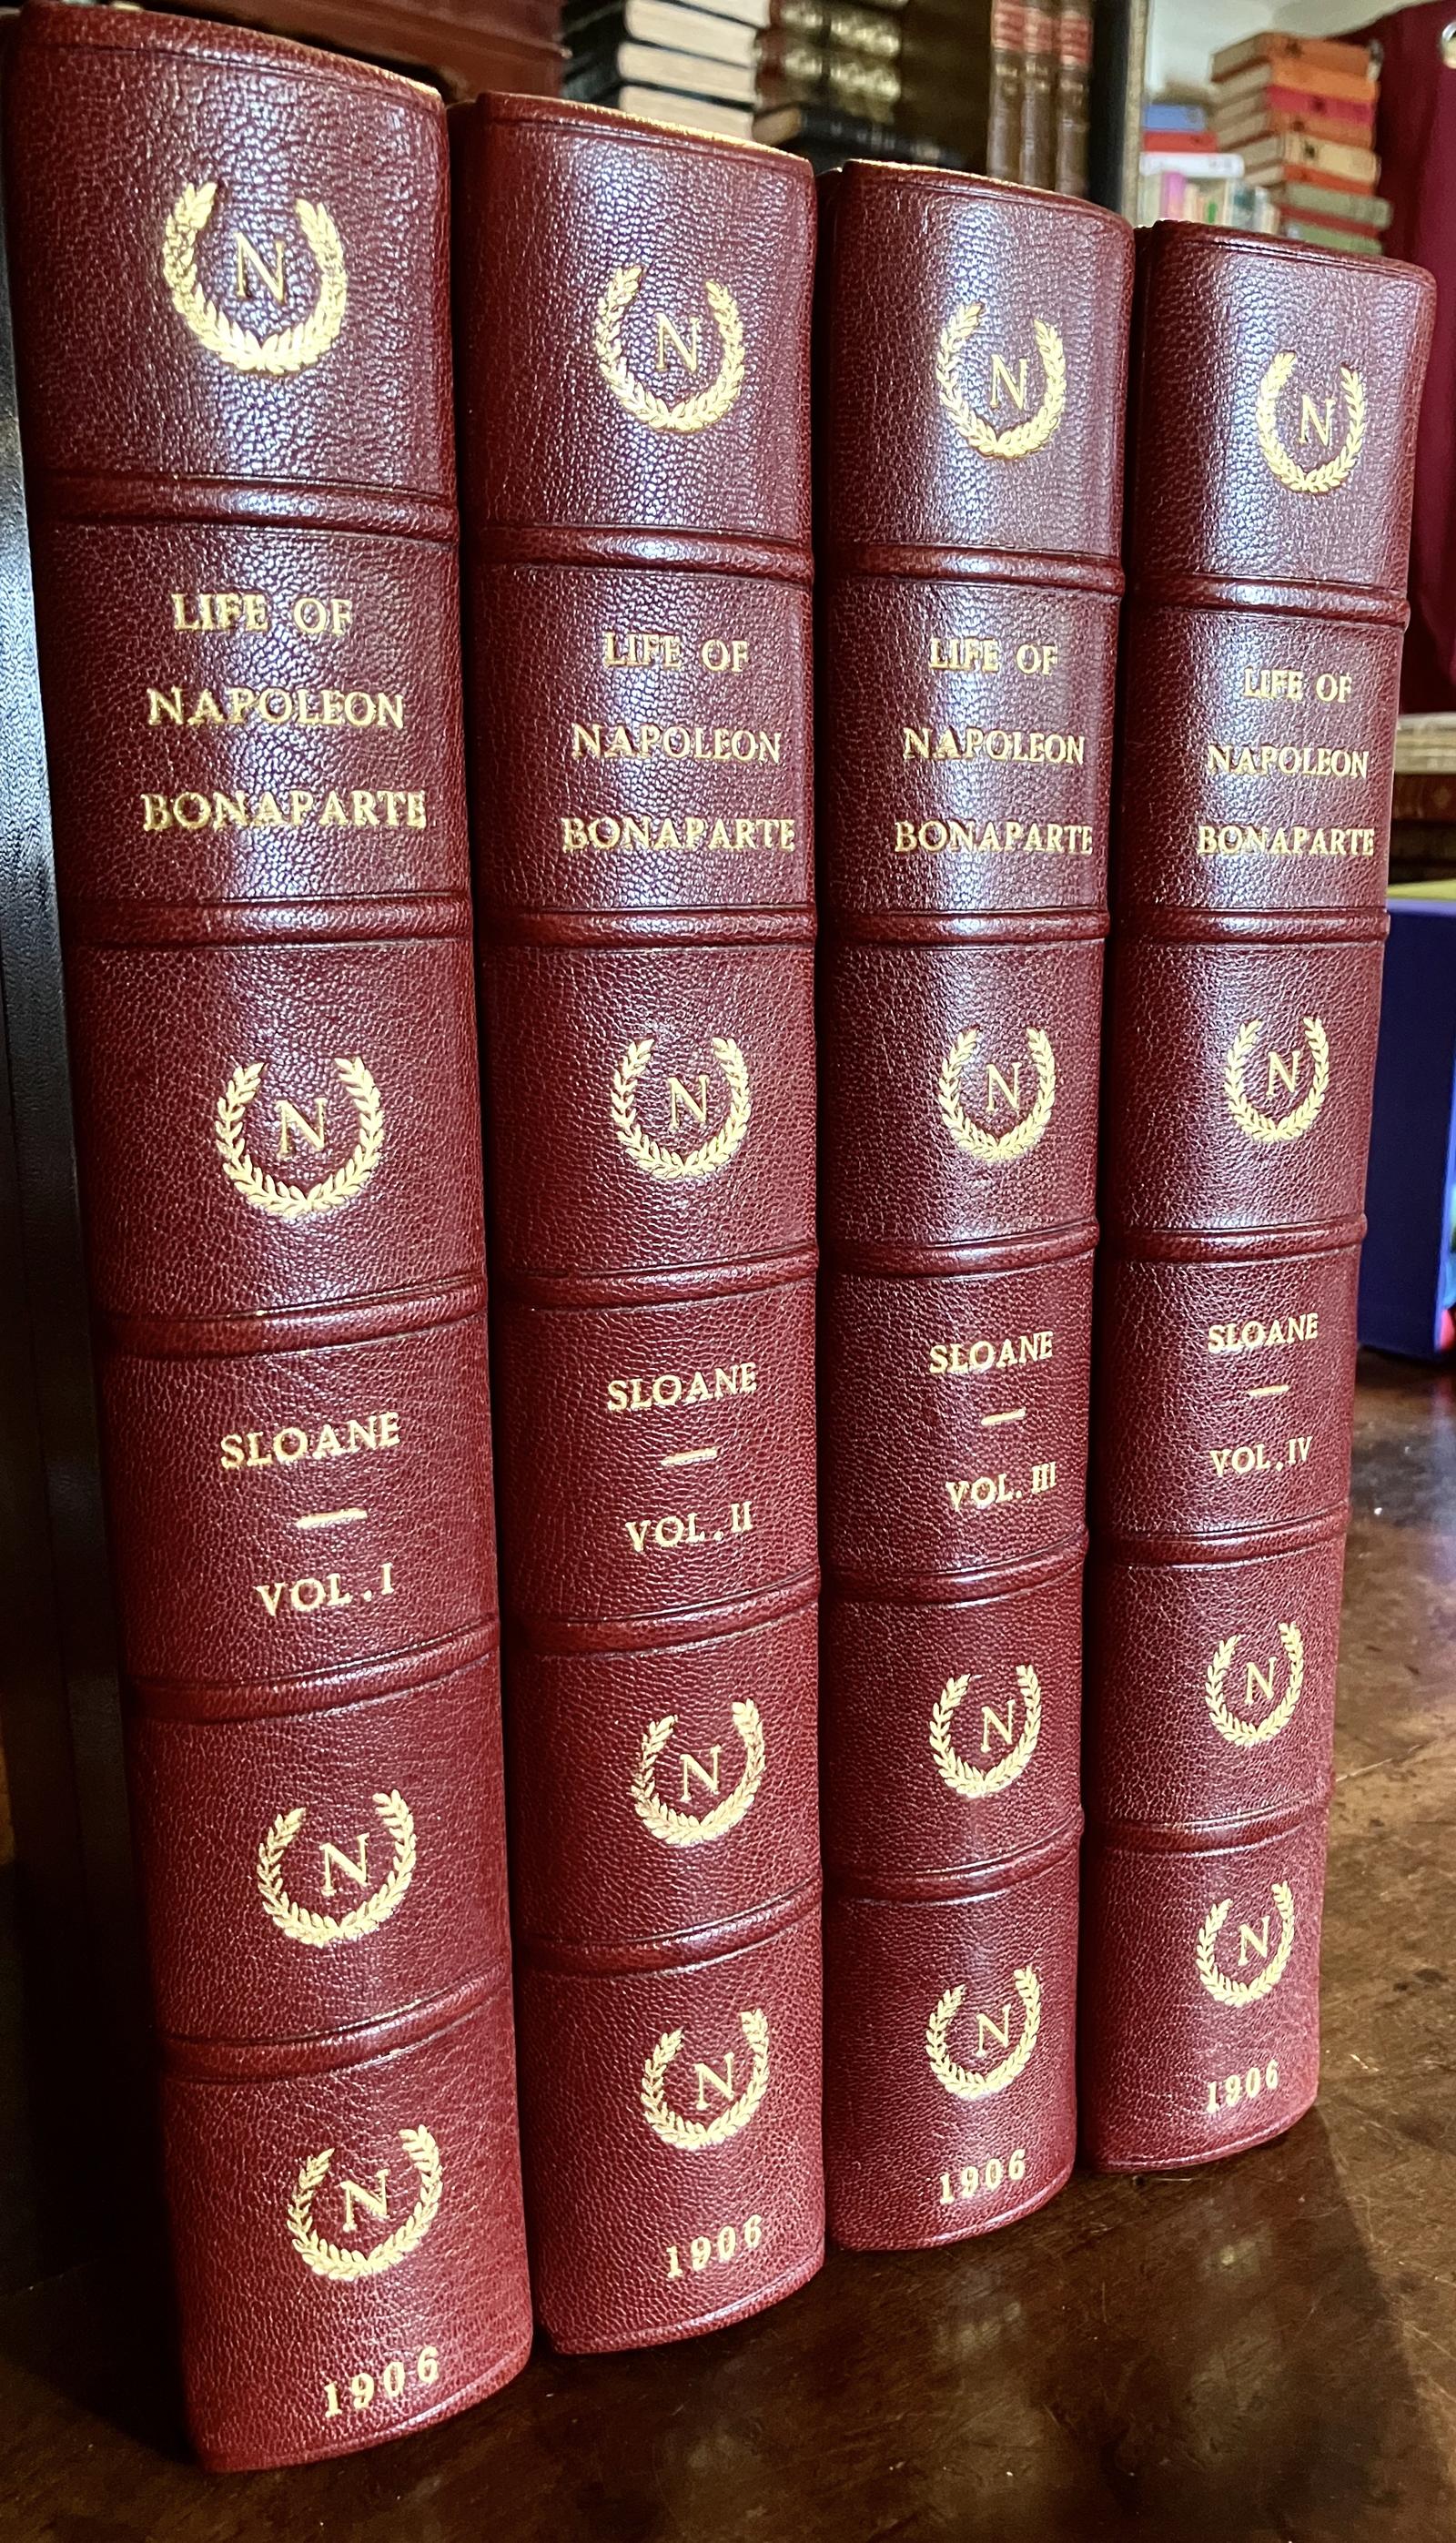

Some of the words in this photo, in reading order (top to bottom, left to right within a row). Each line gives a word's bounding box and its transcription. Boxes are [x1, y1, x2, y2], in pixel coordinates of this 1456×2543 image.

[234, 231, 286, 304] N
[655, 312, 702, 373] N
[989, 354, 1028, 410] N
[1299, 394, 1337, 448] N
[171, 592, 268, 632] LIFE
[292, 597, 353, 635] OF
[602, 632, 682, 669] LIFE
[702, 639, 750, 673] OF
[928, 637, 1000, 672] LIFE
[1016, 643, 1058, 676] OF
[147, 686, 404, 729] NAPOLEON
[1242, 667, 1304, 701] LIFE
[1316, 673, 1353, 704] OF
[571, 723, 783, 764] NAPOLEON
[902, 727, 1086, 765] NAPOLEON
[1207, 745, 1370, 780] NAPOLEON
[140, 790, 428, 832] BONAPARTE
[561, 816, 796, 854] BONAPARTE
[894, 820, 1094, 856] BONAPARTE
[1197, 825, 1375, 856] BONAPARTE
[986, 1061, 1023, 1112] N
[1266, 1049, 1301, 1098] N
[276, 1097, 329, 1160] N
[667, 1074, 710, 1132] N
[928, 1331, 1055, 1374] SLOANE
[1207, 1312, 1320, 1354] SLOANE
[606, 1362, 758, 1411] SLOANE
[220, 1412, 401, 1470] SLOANE
[1244, 1656, 1278, 1705] N
[980, 1698, 1016, 1754] N
[679, 1743, 723, 1802] N
[318, 1831, 371, 1898] N
[1238, 1914, 1271, 1967] N
[976, 2003, 1012, 2059] N
[694, 2052, 735, 2111] N
[1206, 2059, 1279, 2115] 1906
[339, 2168, 391, 2233] N
[939, 2149, 1026, 2205] 1906
[665, 2213, 763, 2279] 1906
[324, 2345, 440, 2418] 1906
